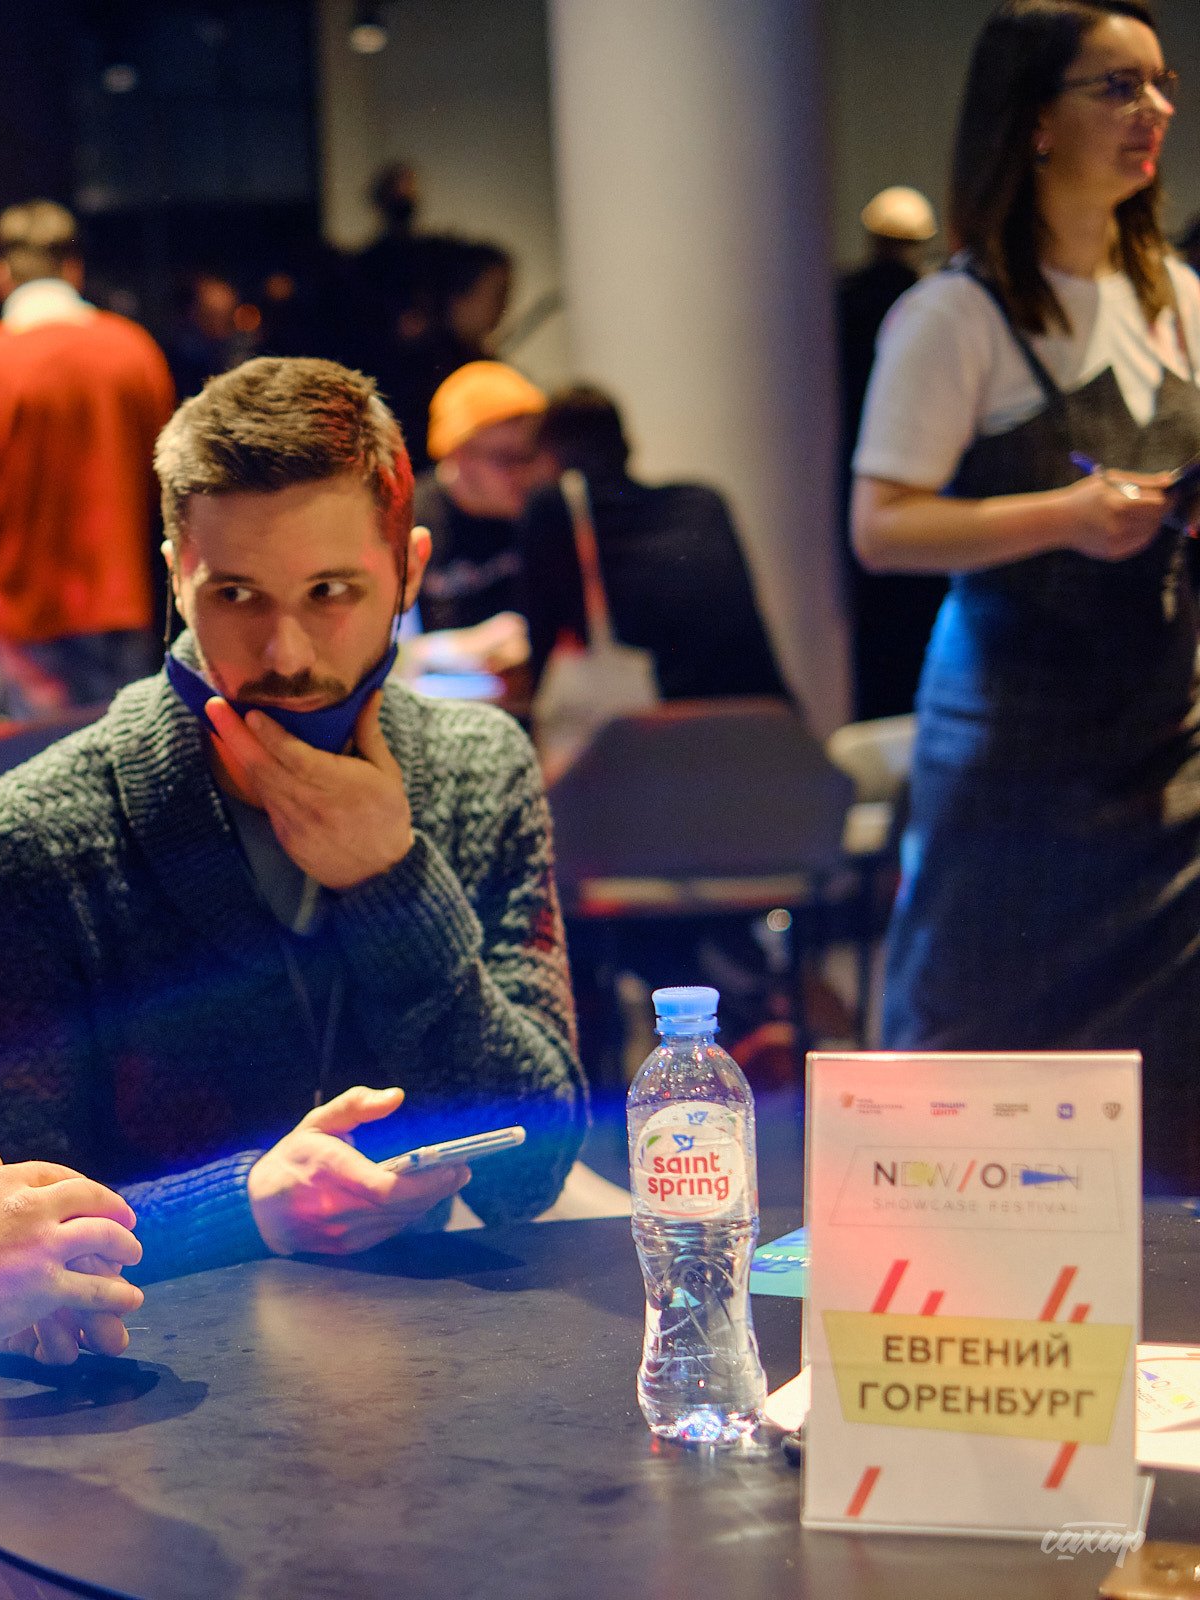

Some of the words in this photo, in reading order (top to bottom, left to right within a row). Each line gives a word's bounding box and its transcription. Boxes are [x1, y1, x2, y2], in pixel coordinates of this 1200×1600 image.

[653, 1152, 720, 1174] saint
[648, 1175, 729, 1201] spring
[872, 1198, 977, 1212] SHOWCASE
[883, 1333, 1072, 1369] ЕВГЕНИЙ
[859, 1382, 1095, 1418] ГОРЕНБУРГ
